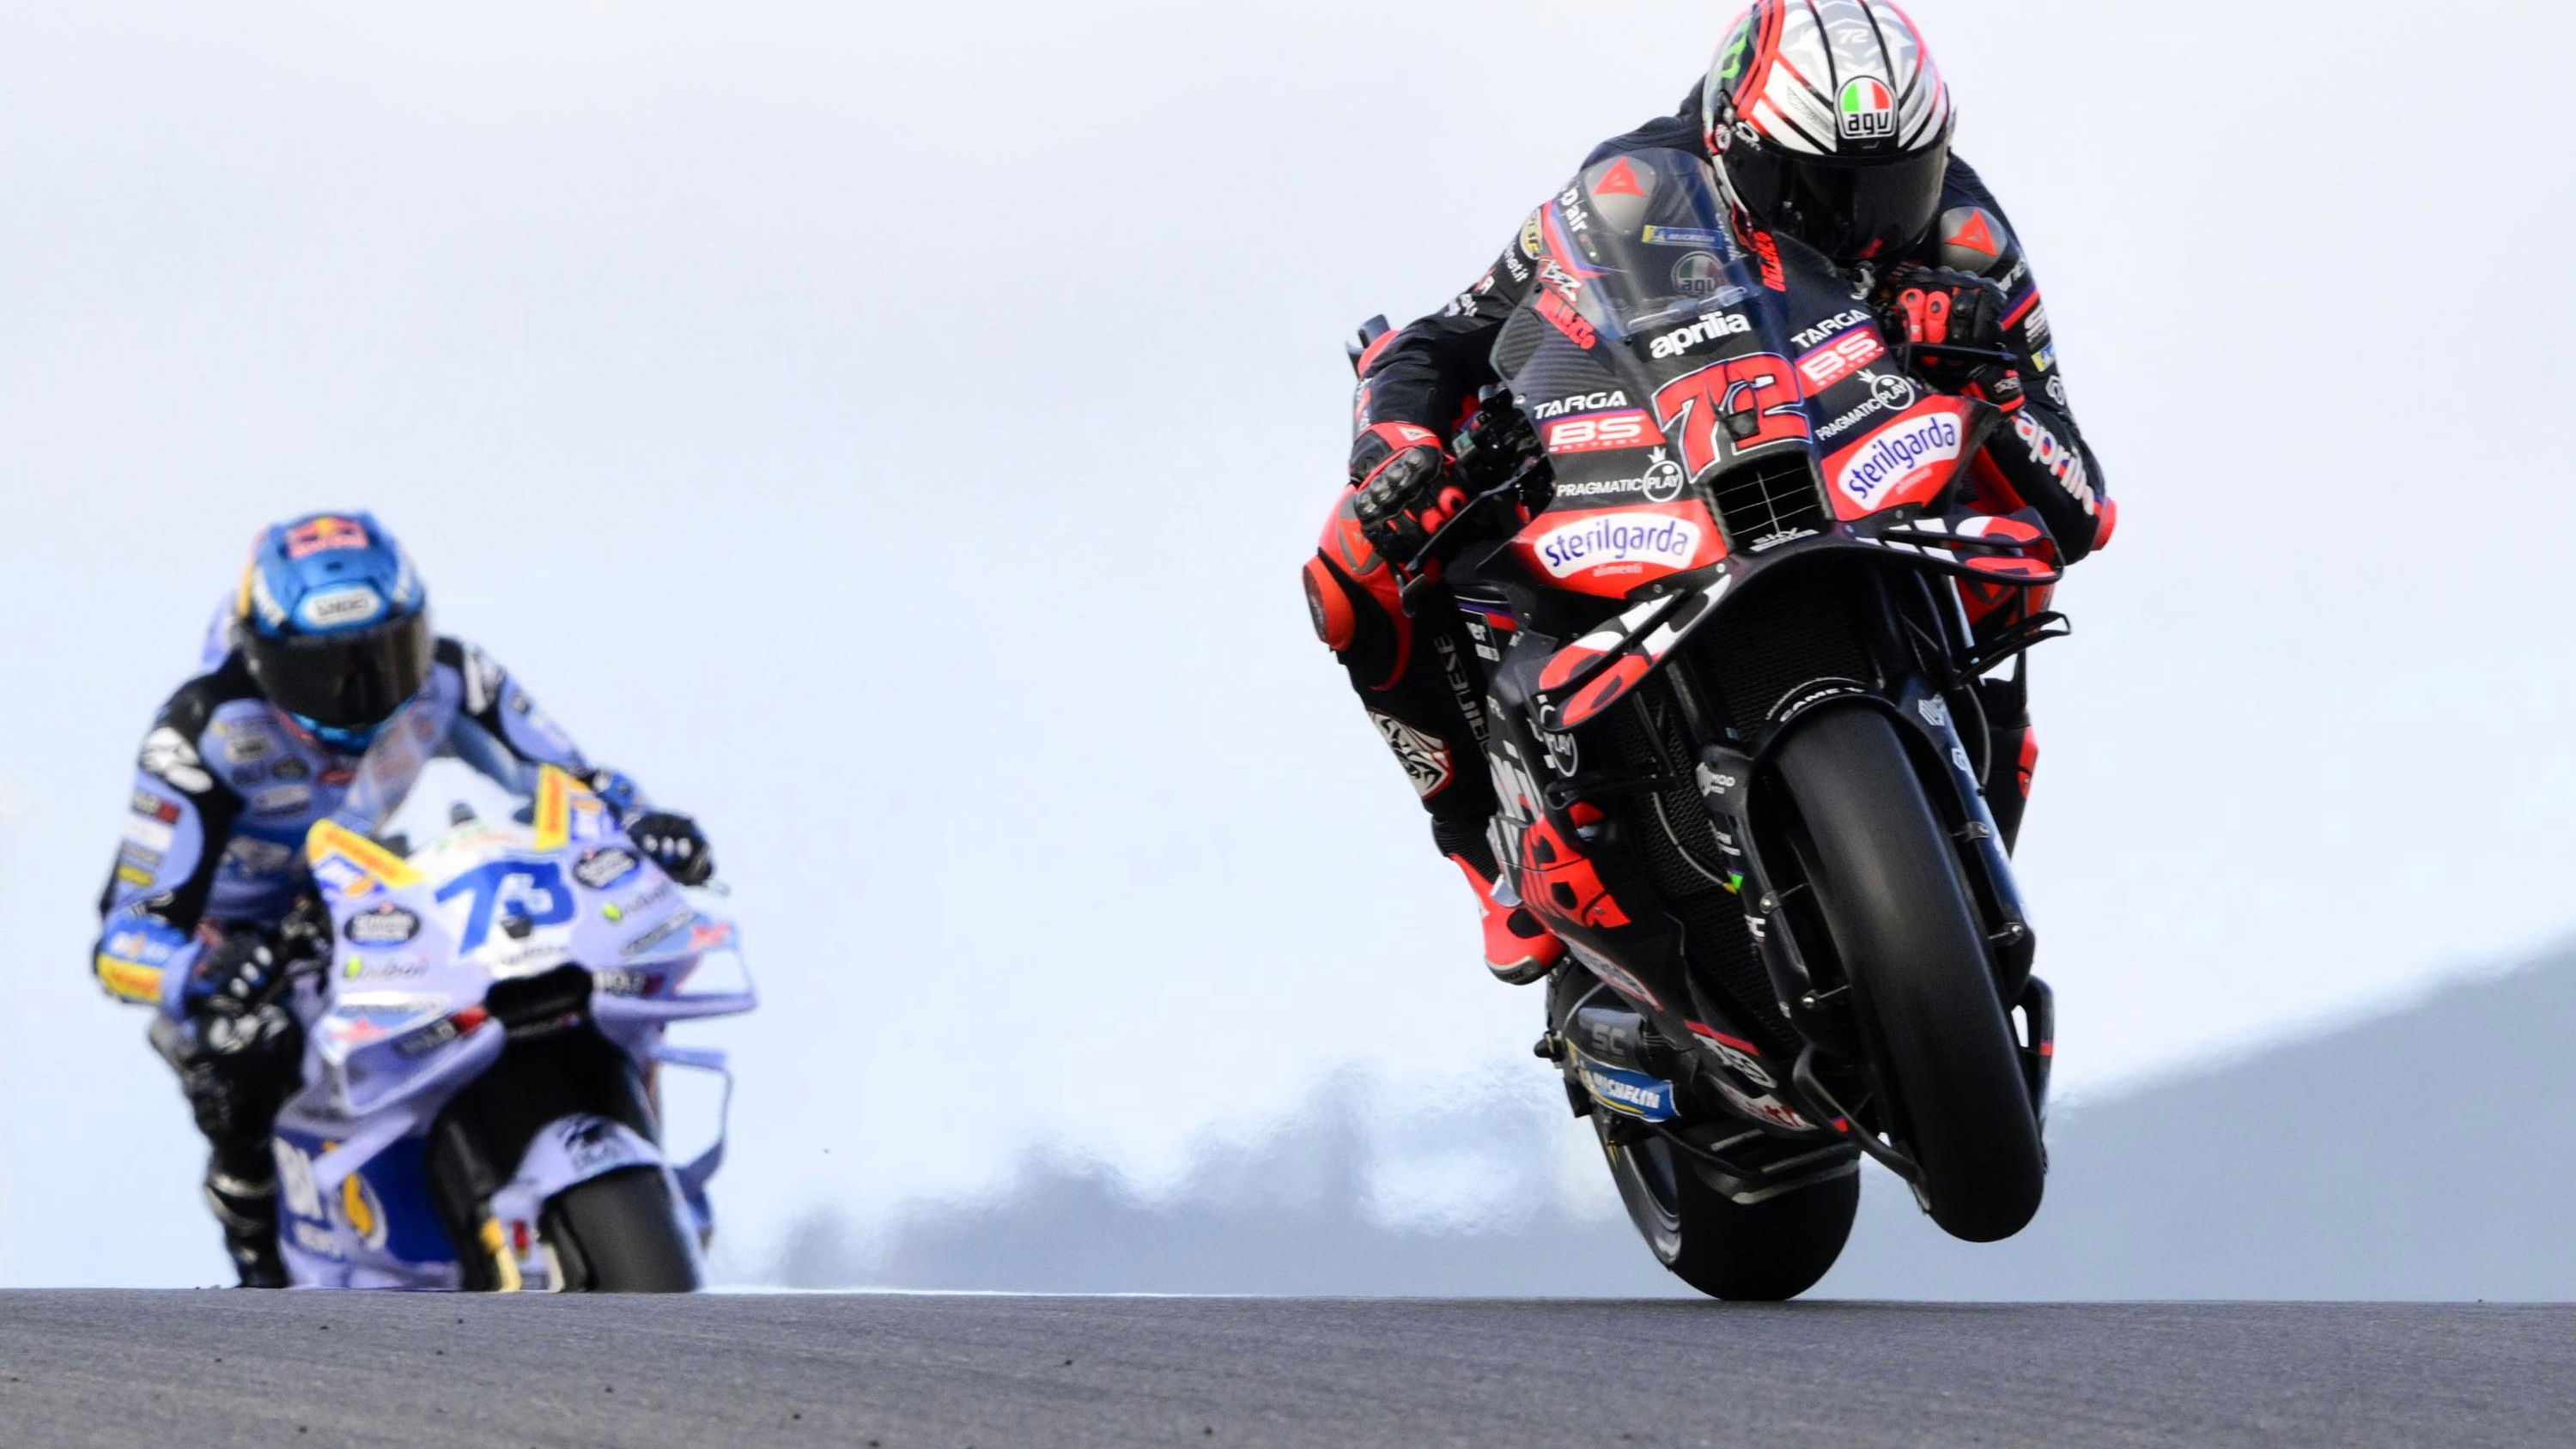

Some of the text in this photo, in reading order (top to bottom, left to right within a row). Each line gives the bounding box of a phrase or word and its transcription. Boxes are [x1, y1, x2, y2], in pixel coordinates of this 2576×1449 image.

[1838, 28, 1868, 44] 72
[1848, 112, 1889, 136] agv
[1649, 311, 1752, 359] aprilia
[1790, 309, 1872, 349] TARGA
[1800, 330, 1878, 383] BS
[1534, 390, 1627, 420] TARGA
[1650, 356, 1814, 484] 72
[1814, 381, 1907, 441] PRAGMATIC PLAY
[1549, 415, 1646, 446] BS
[1849, 416, 1955, 500] sterilgarda
[1556, 474, 1679, 497] PRAGMATIC PLAY
[1545, 518, 1688, 567] sterilgarda
[434, 860, 576, 956] 73
[1591, 1022, 1626, 1056] SC
